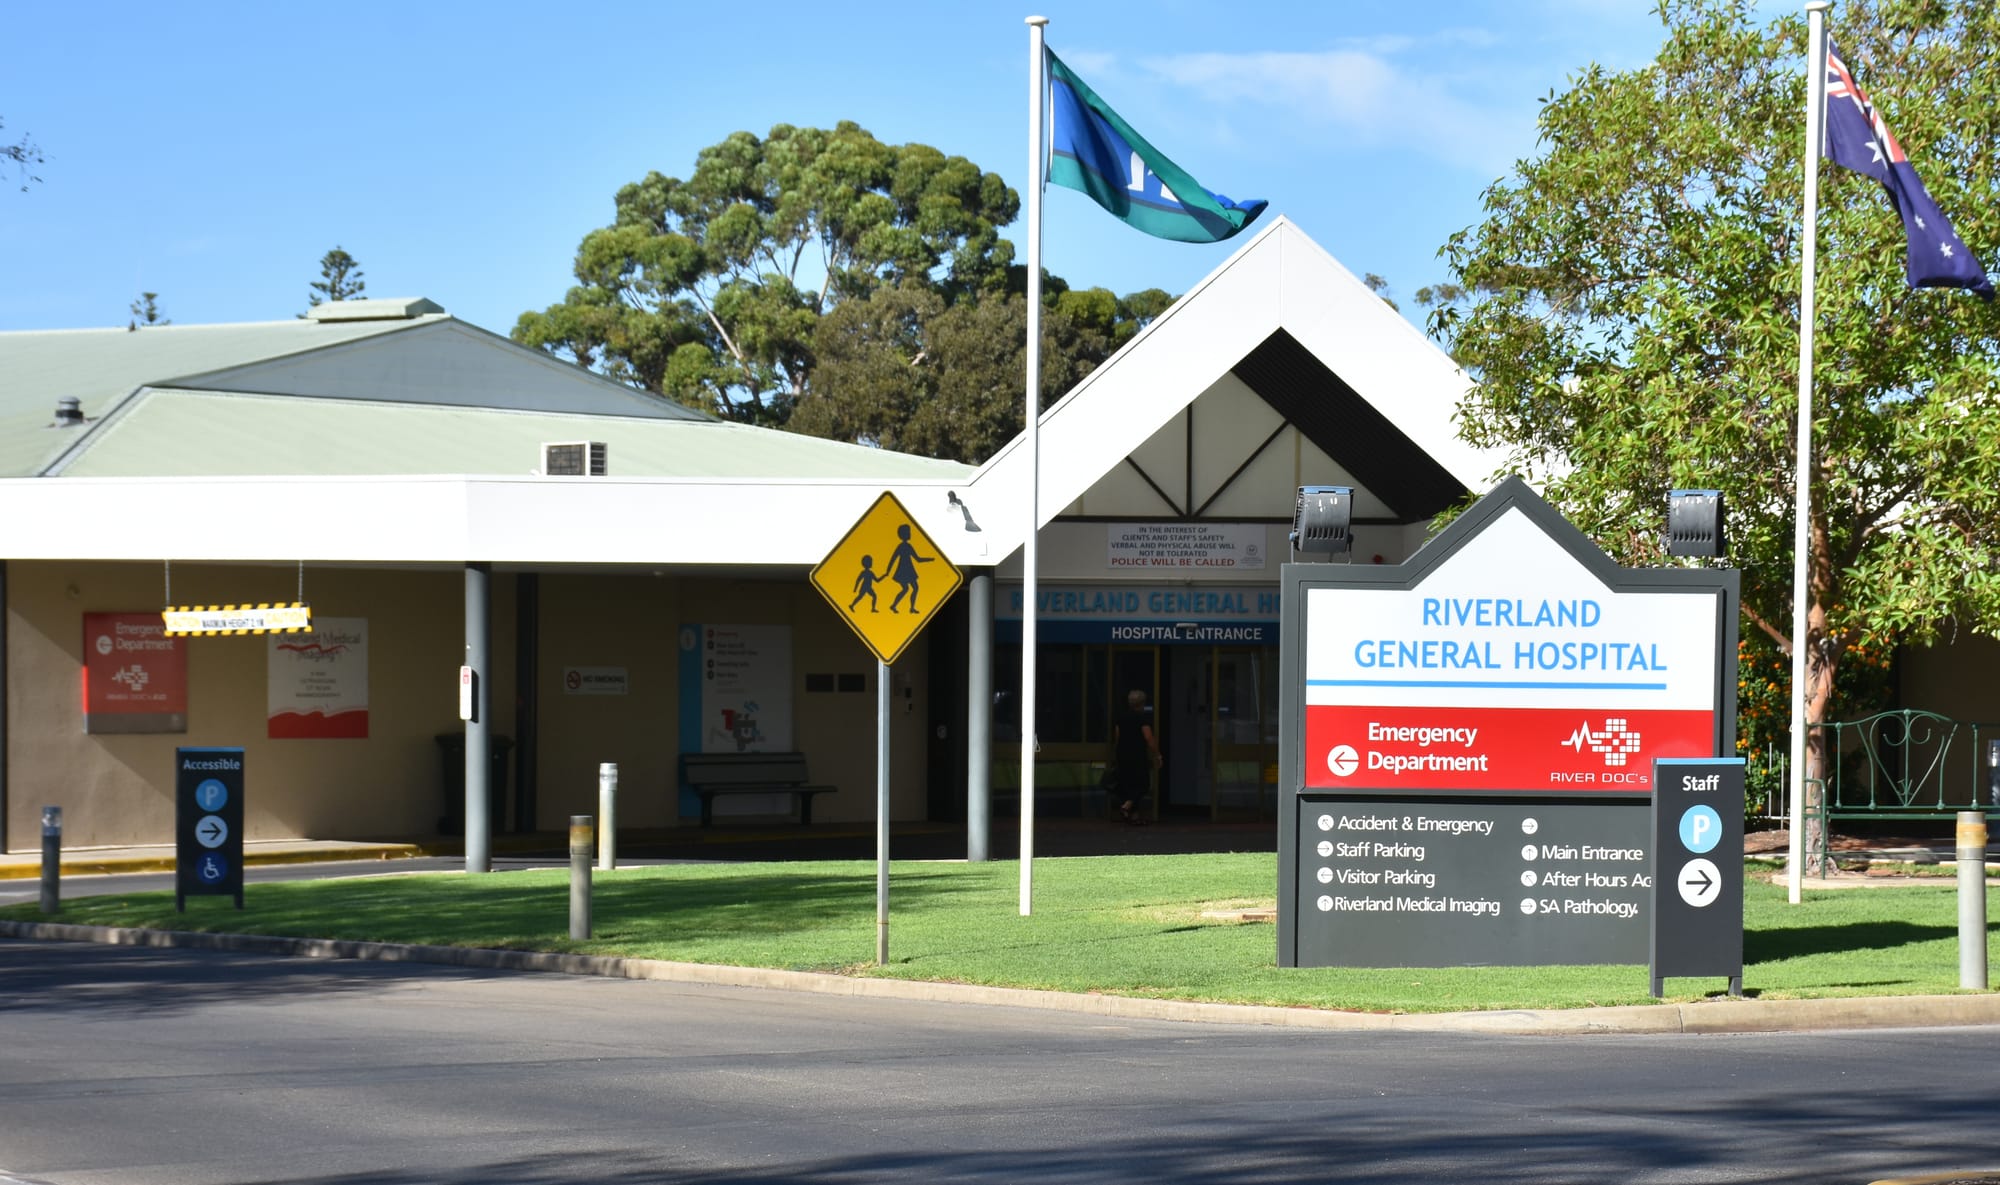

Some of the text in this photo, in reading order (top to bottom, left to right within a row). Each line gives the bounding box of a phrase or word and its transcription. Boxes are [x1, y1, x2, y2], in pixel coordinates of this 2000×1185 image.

[1111, 558, 1148, 566] POLICE
[1151, 558, 1175, 566] WILL
[1179, 558, 1192, 566] BE
[1195, 558, 1236, 566] CALLED
[1010, 591, 1139, 613] RVERLAND
[1148, 592, 1249, 613] GENERAL
[1423, 598, 1601, 627] RIVERLAND
[1111, 626, 1262, 640] HOSPITAL ENTRANCE
[116, 637, 174, 653] Department
[1354, 640, 1667, 671] GENERAL HOSPITAL
[1368, 722, 1477, 748] Emergency
[183, 758, 241, 770] Accessible
[1367, 751, 1488, 776] Department
[1550, 772, 1648, 784] RIVER DOC's
[1682, 775, 1720, 791] Staff
[205, 785, 219, 806] P
[1338, 815, 1494, 835] Accident & Emergency
[1692, 814, 1711, 845] P
[1336, 842, 1425, 862] Staff Parking
[1542, 845, 1644, 861] Main Entrance
[1336, 868, 1436, 888] Visitor Parking
[1542, 871, 1582, 887] After
[1585, 873, 1627, 888] Hours
[1335, 896, 1500, 916] Riverland Medical Imaging
[1539, 899, 1560, 914] SA
